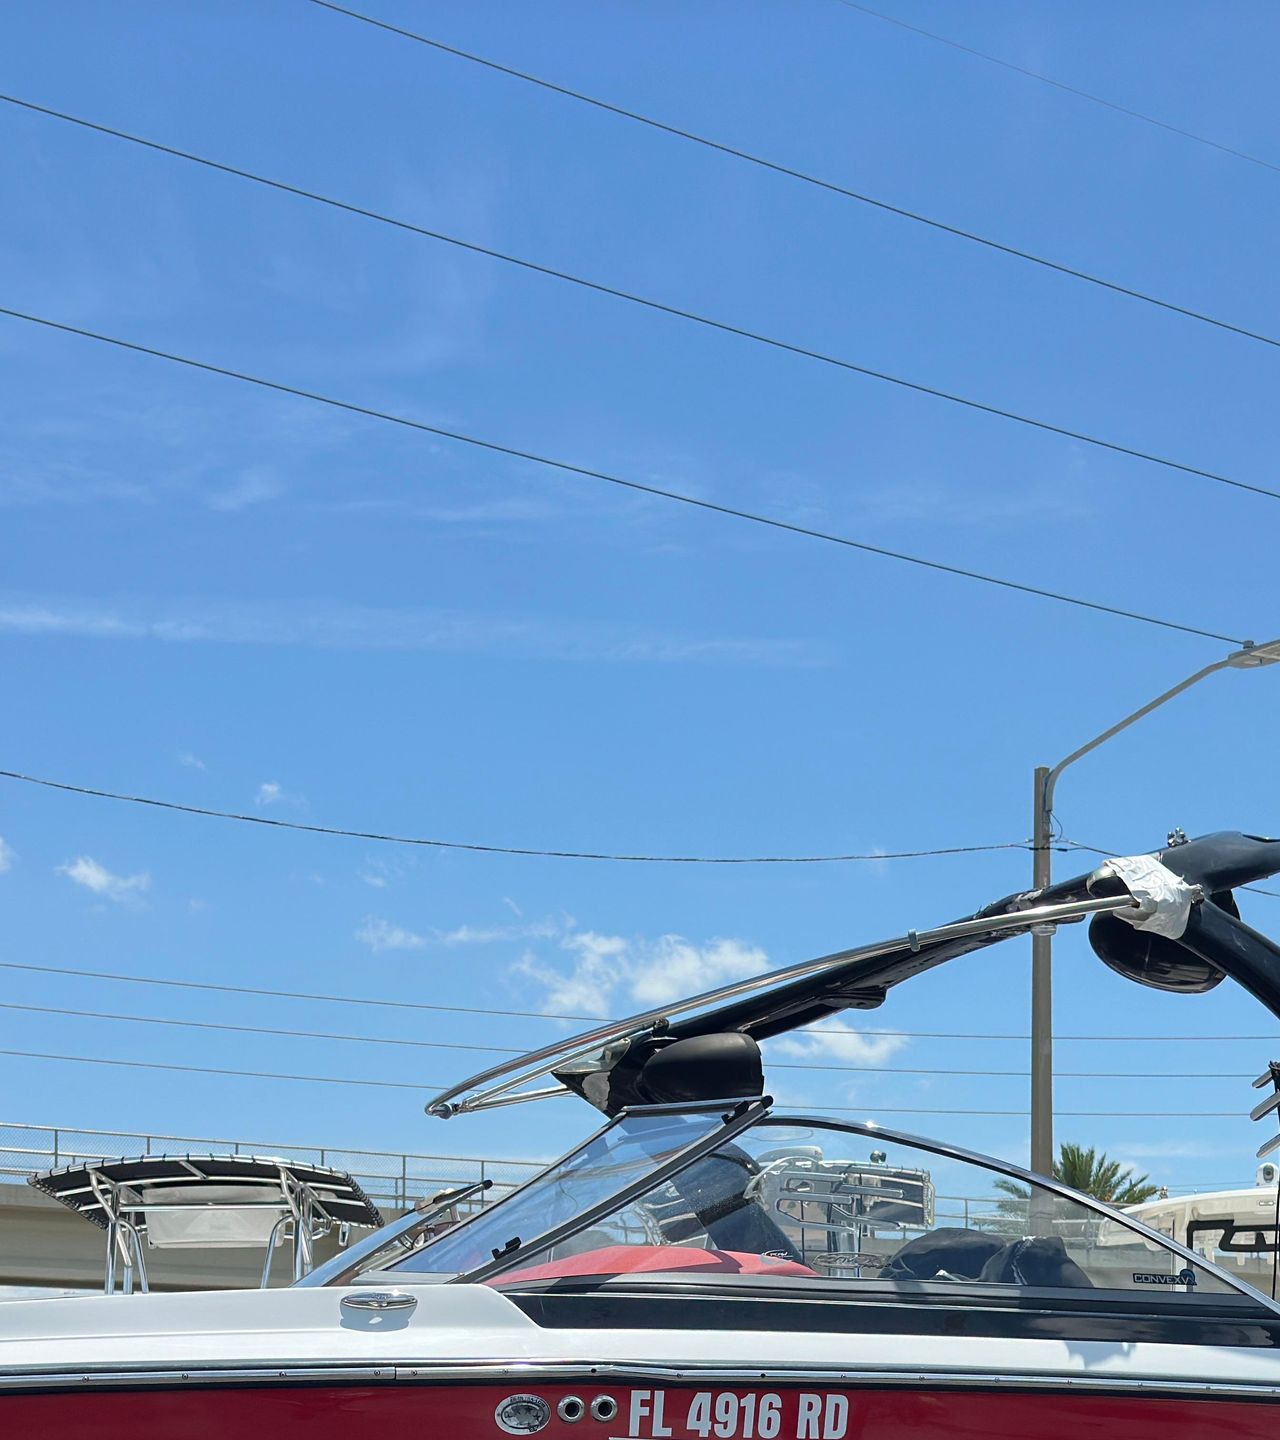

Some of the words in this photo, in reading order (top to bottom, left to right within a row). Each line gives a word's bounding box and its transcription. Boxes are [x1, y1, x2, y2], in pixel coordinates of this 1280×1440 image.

[628, 1389, 673, 1437] FL
[686, 1391, 781, 1440] 4916
[796, 1393, 849, 1440] RD
